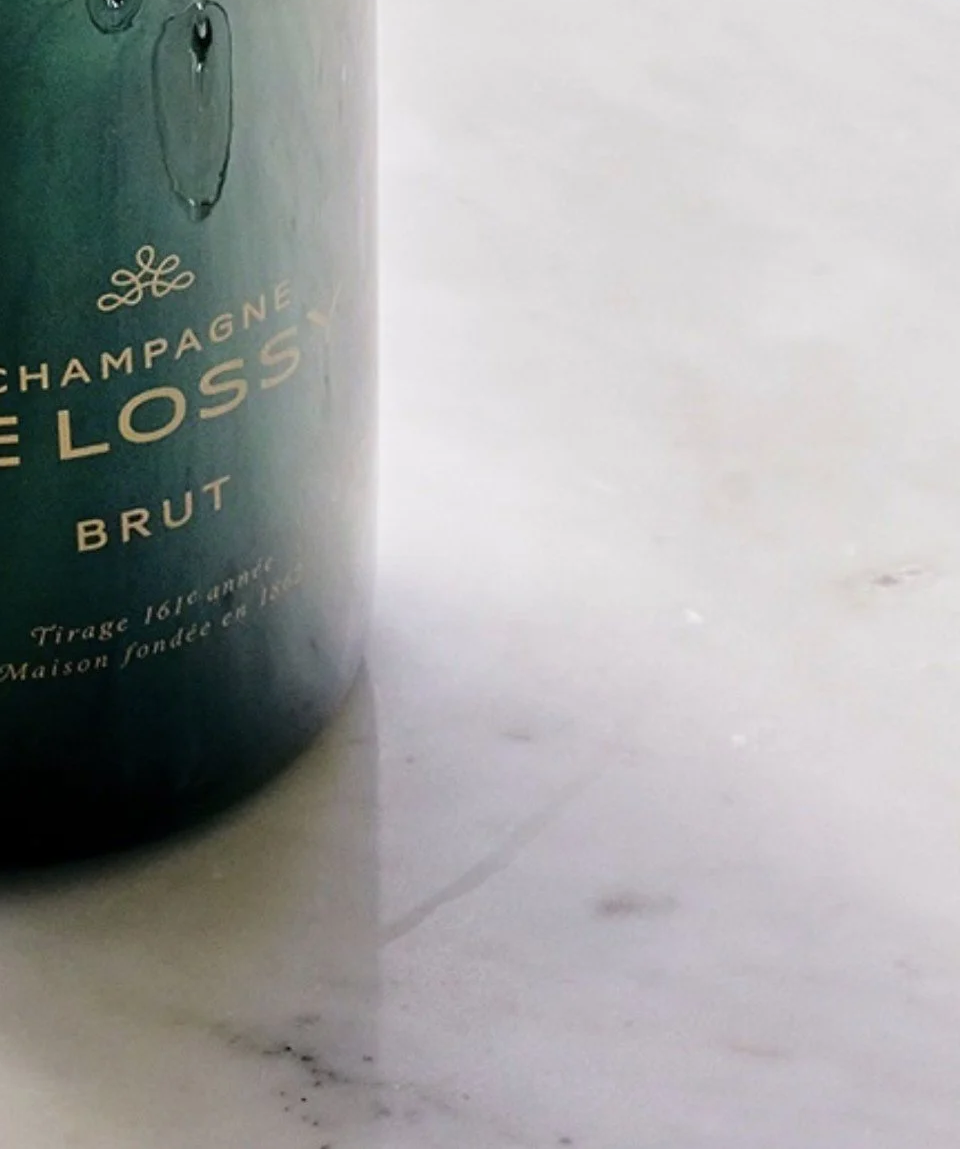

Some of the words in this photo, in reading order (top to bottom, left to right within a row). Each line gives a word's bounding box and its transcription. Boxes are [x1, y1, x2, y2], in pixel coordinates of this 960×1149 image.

[57, 284, 341, 460] LOSSY
[76, 476, 230, 552] BRUT
[30, 617, 129, 646] Tirage
[120, 621, 211, 670] fondée
